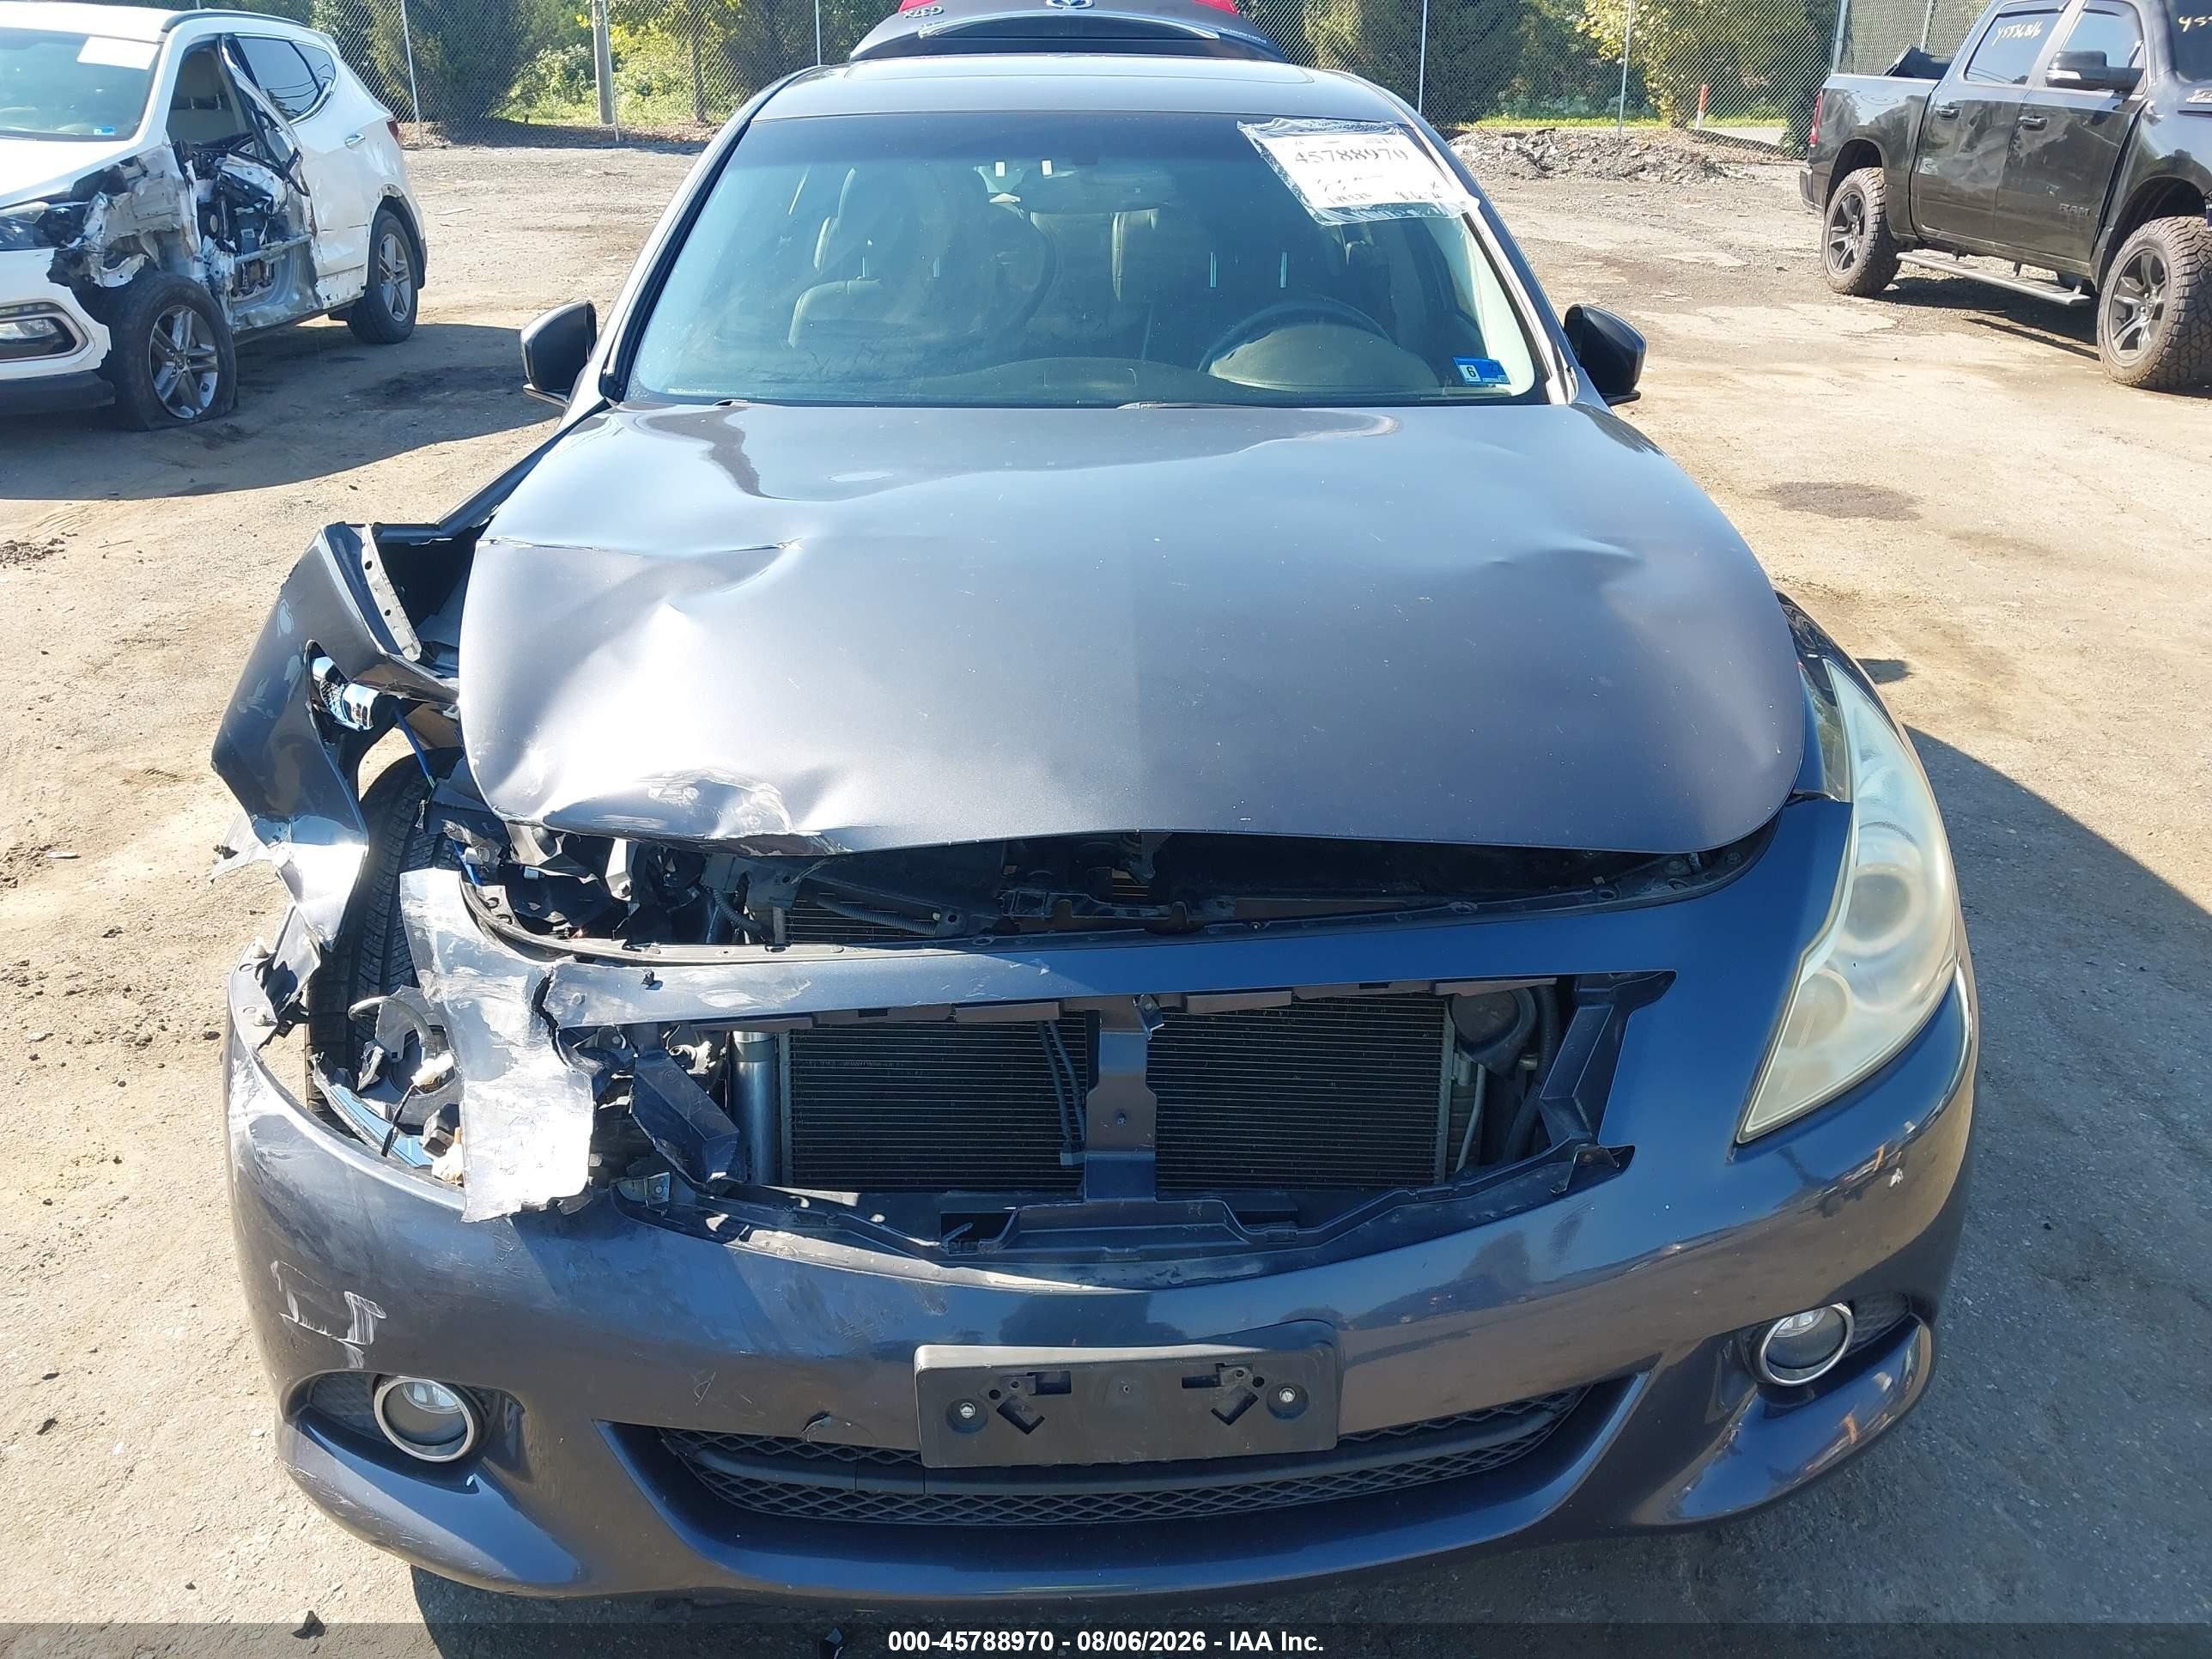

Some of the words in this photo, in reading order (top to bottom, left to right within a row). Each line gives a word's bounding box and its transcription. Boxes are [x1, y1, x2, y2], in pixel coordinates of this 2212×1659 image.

[1295, 149, 1409, 163] 45788970
[2060, 203, 2090, 216] RAM
[1467, 366, 1476, 378] 6
